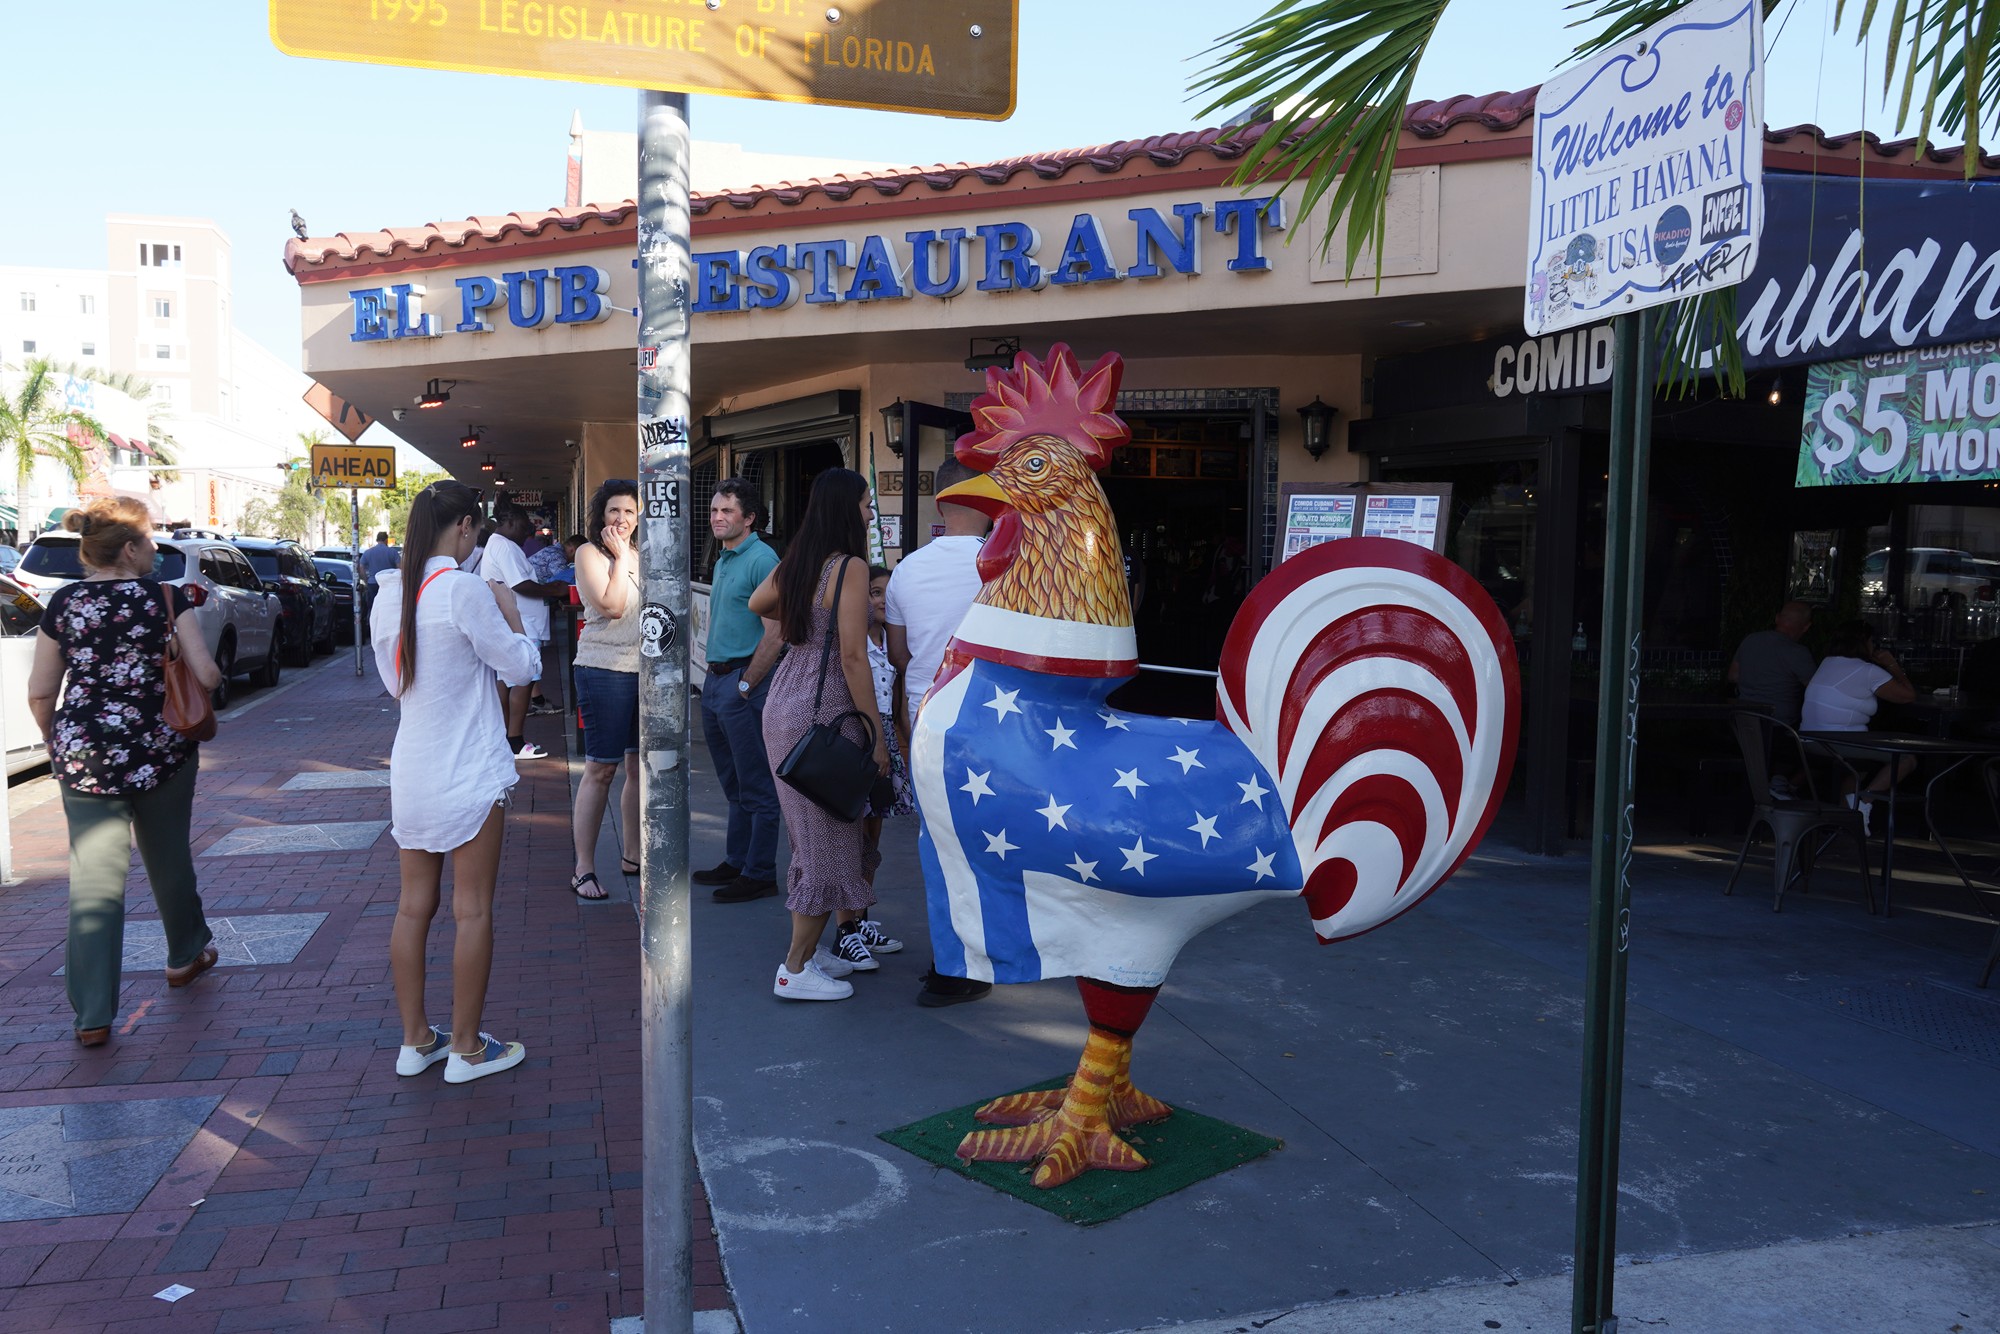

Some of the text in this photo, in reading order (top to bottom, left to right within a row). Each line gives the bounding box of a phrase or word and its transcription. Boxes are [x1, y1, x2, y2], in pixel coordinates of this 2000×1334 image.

[479, 0, 706, 53] LEGISLATURE
[735, 24, 777, 59] OF
[803, 31, 936, 77] FLORIDA
[1552, 90, 1691, 180] Welcome
[1701, 64, 1735, 120] to
[1546, 134, 1734, 242] LITTLE HAVANA
[349, 197, 1287, 343] EL PUB ESTAURANT
[1607, 225, 1653, 275] USA
[1654, 227, 1691, 242] PIKADIYO
[1493, 324, 1616, 398] COMID
[1815, 374, 1908, 474] $5
[319, 457, 391, 477] AHEAD
[647, 482, 677, 501] LEC
[884, 474, 930, 492] 158
